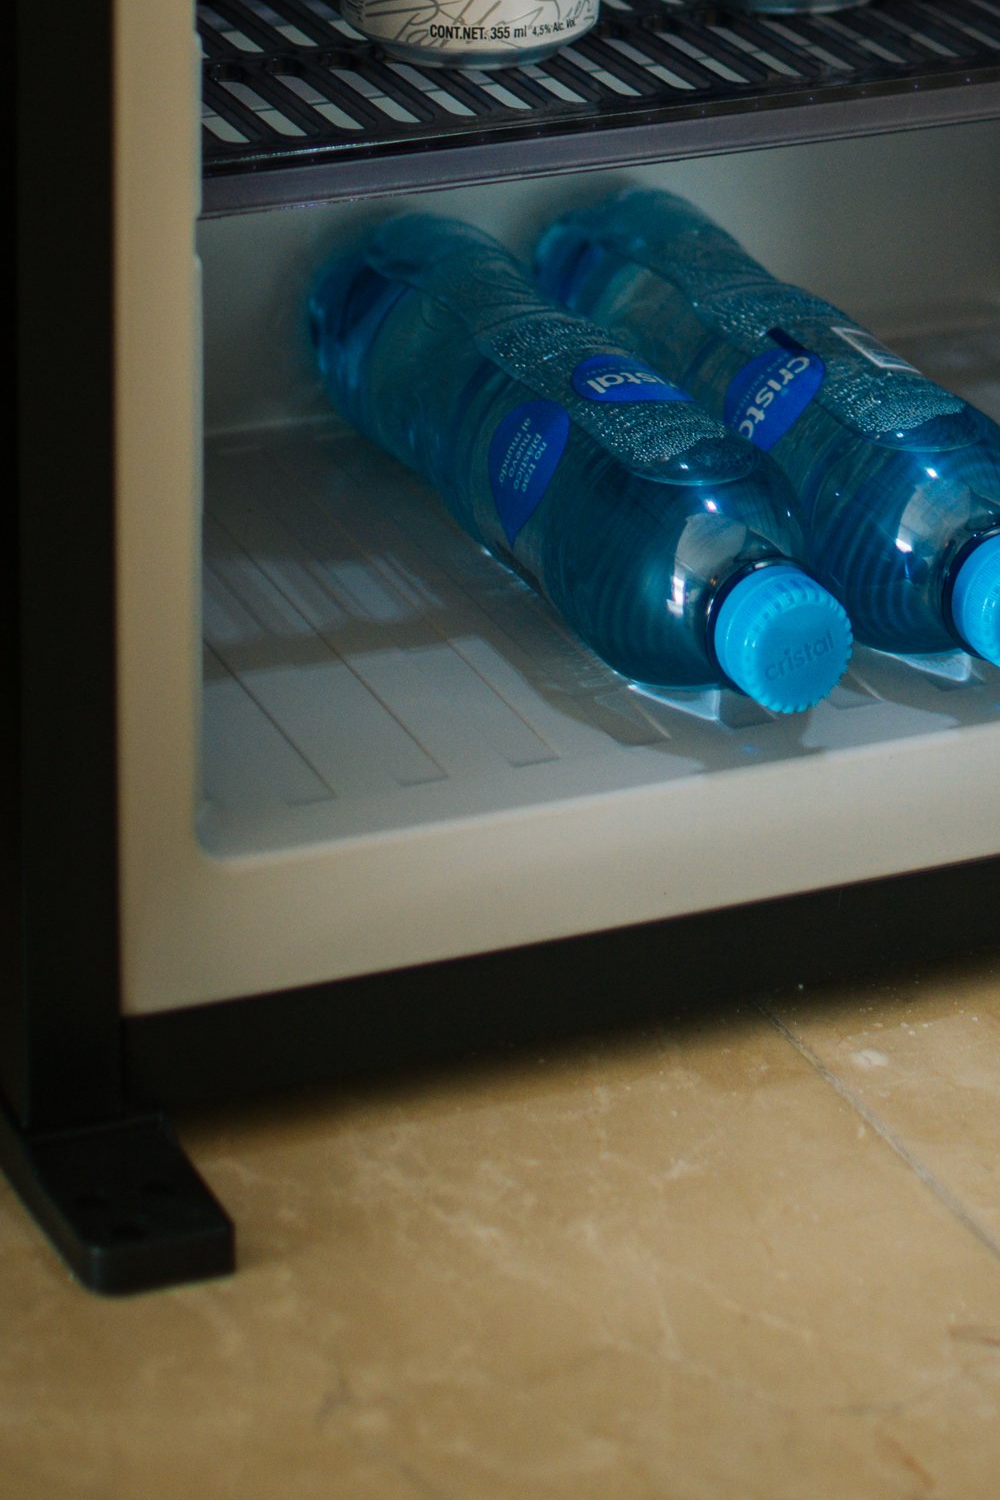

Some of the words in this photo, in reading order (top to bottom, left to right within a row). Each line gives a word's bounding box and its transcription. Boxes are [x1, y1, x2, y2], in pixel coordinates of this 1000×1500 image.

[490, 26, 510, 39] 355
[514, 25, 527, 38] ml
[532, 24, 551, 37] 4,5%
[521, 418, 531, 431] al
[508, 433, 531, 478] nuevo
[534, 441, 548, 460] no
[521, 463, 536, 492] trae
[765, 629, 834, 680] cristal
